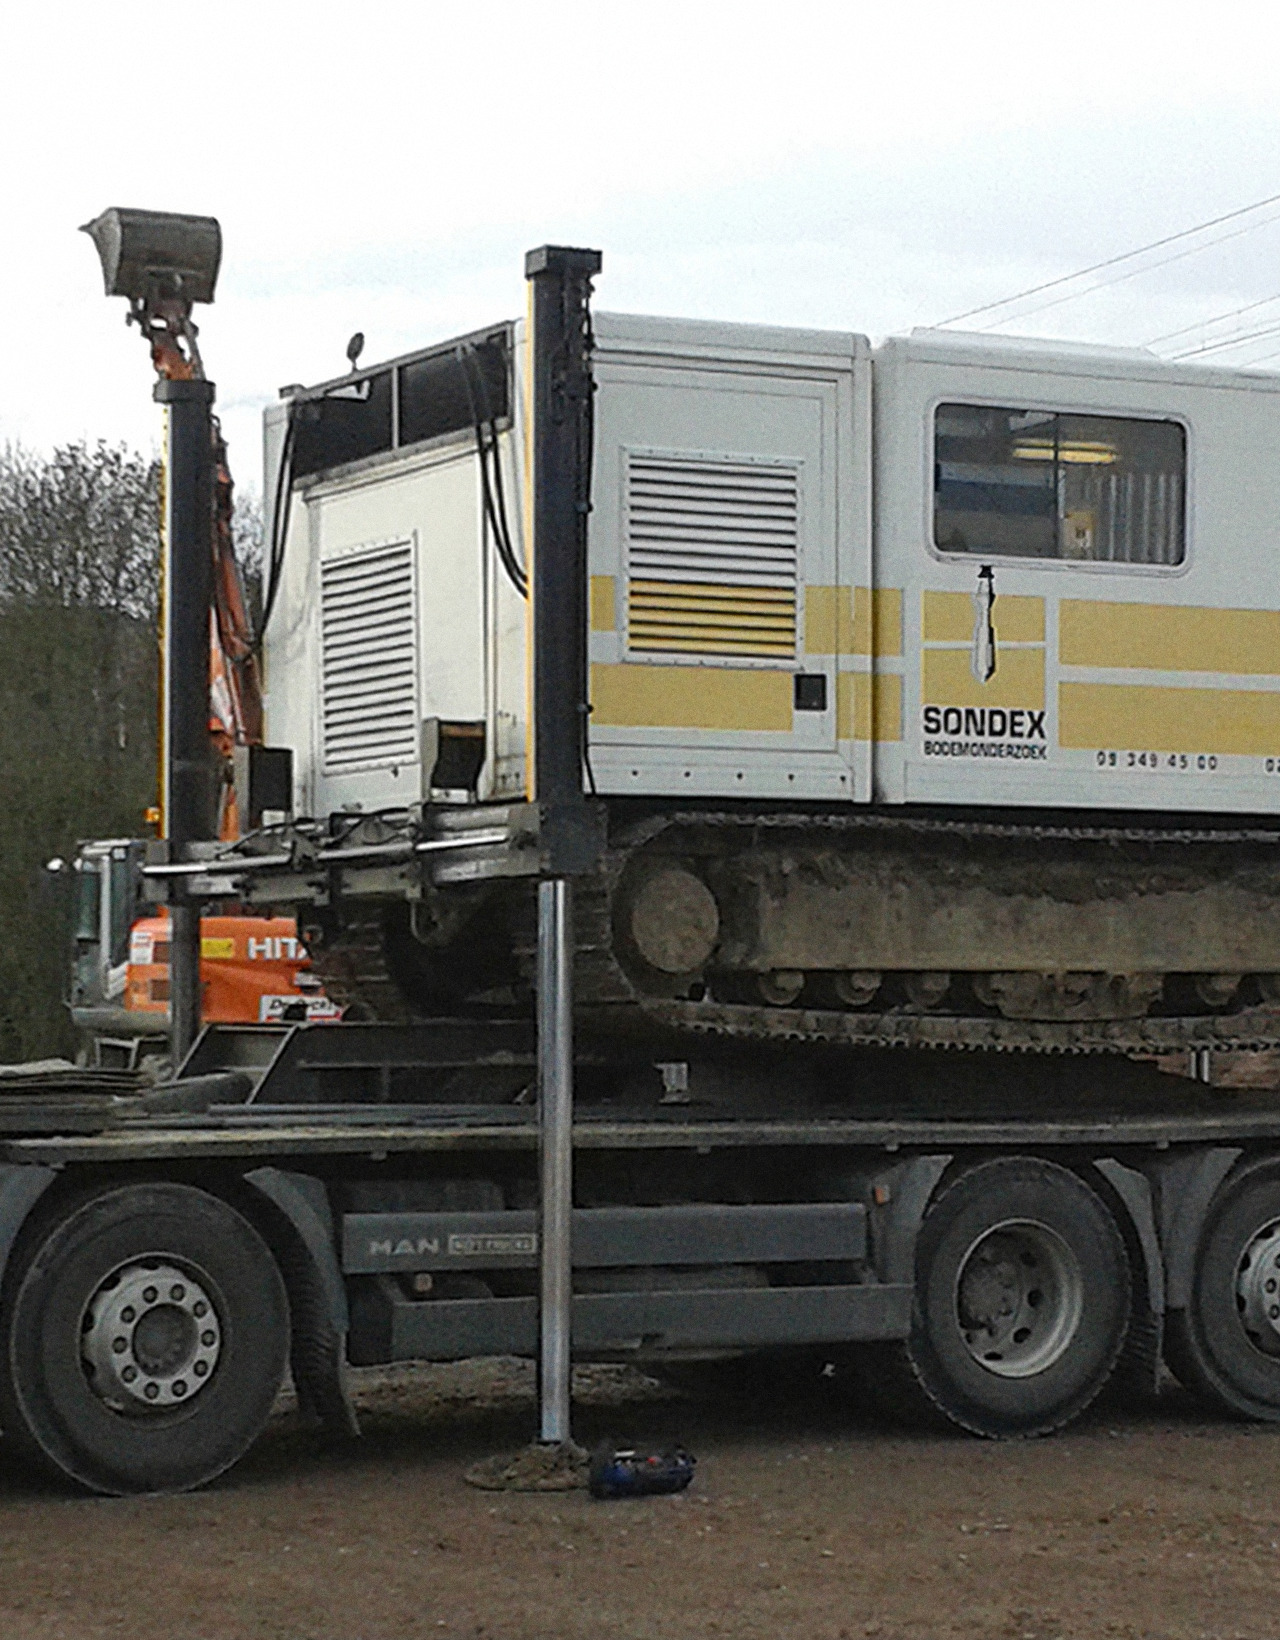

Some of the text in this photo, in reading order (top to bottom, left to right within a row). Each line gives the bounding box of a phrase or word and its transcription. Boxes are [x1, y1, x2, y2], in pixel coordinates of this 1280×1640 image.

[923, 706, 1046, 739] SONDEX
[923, 740, 1048, 760] BODEMONDERZOEK
[1096, 751, 1218, 771] 09 349 45 00
[370, 1239, 439, 1255] MAN
